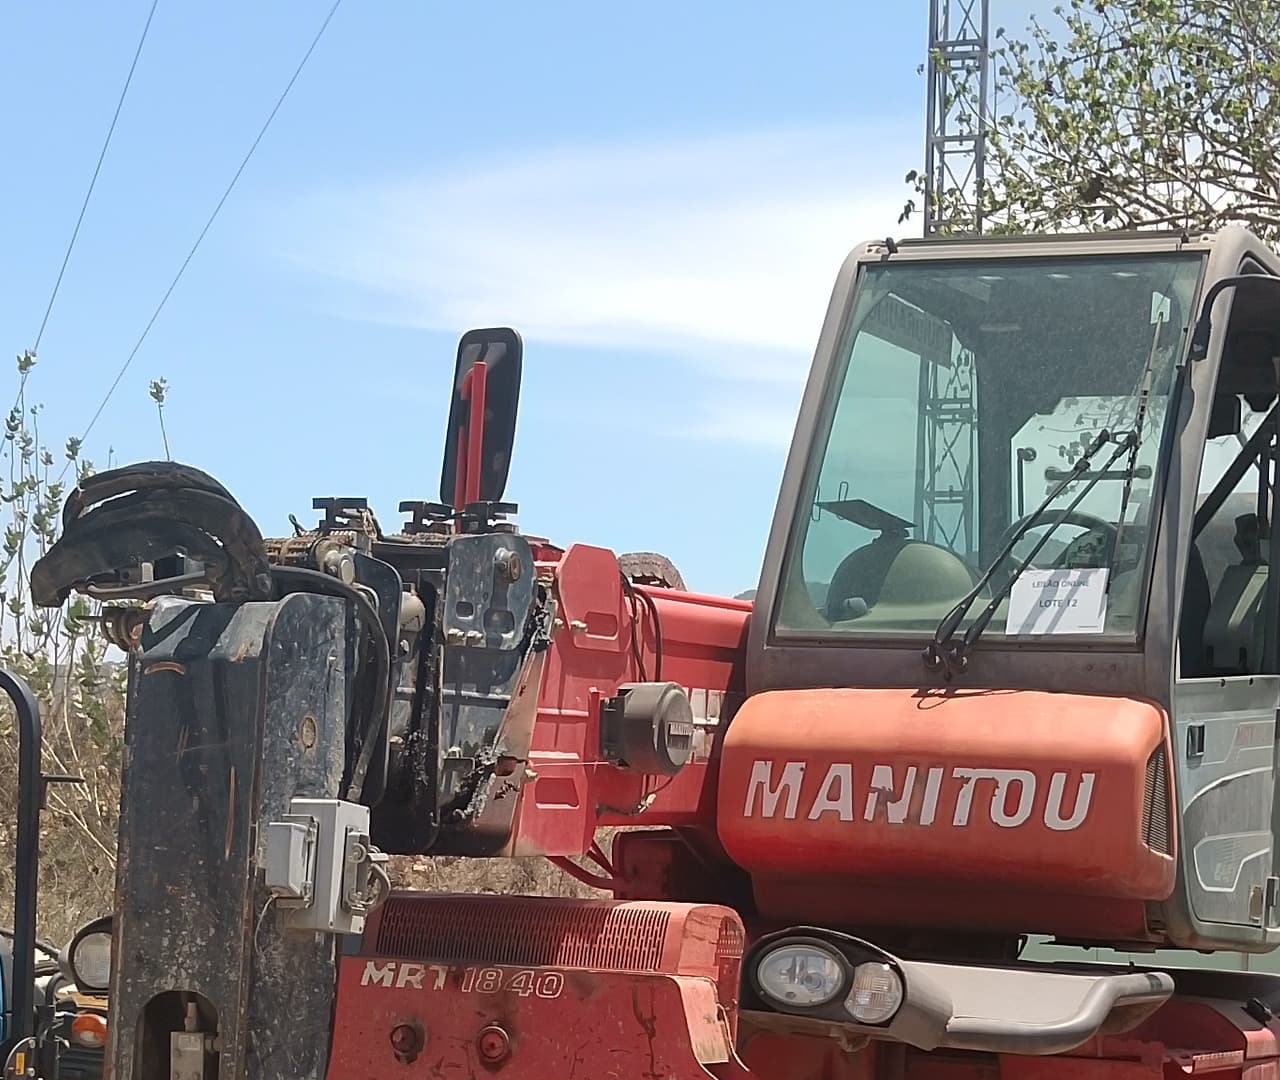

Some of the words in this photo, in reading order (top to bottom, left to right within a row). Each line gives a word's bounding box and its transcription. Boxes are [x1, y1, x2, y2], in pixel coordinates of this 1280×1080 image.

[1039, 599, 1063, 608] LOTE
[744, 760, 1096, 831] MANITOU
[360, 960, 456, 991] MRT
[461, 966, 565, 999] 1840
